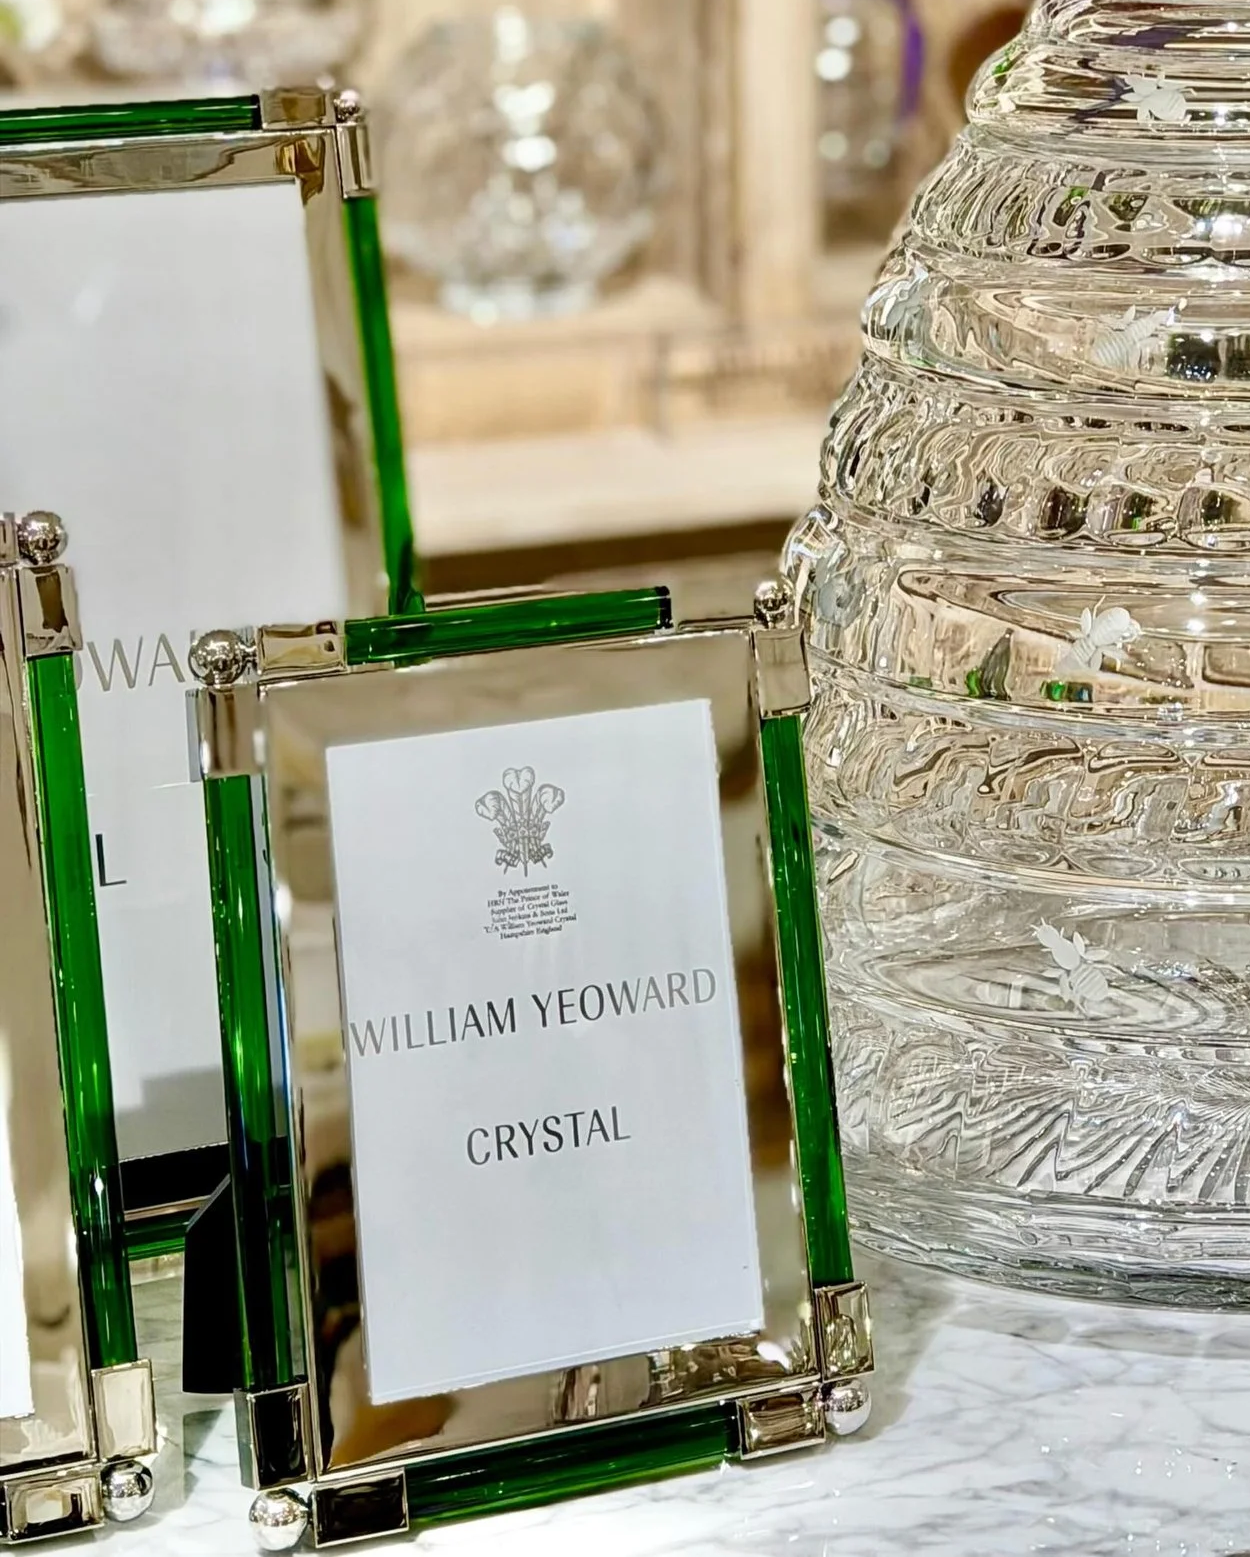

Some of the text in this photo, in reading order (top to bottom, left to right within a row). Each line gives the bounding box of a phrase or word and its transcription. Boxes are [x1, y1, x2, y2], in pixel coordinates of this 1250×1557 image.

[349, 967, 717, 1057] WILLIAM YEOWARD
[466, 1105, 631, 1166] CRYSTAL
